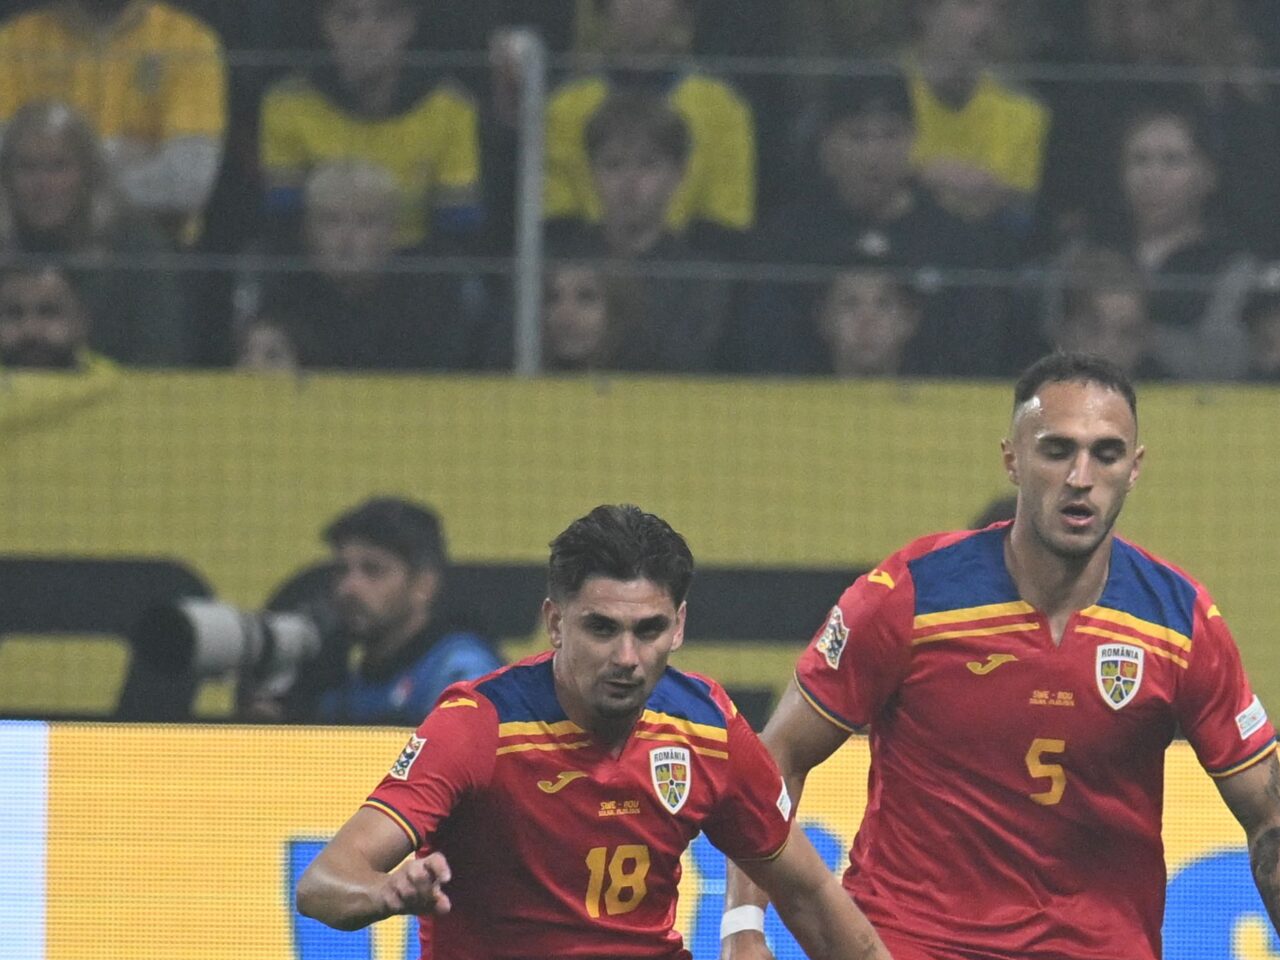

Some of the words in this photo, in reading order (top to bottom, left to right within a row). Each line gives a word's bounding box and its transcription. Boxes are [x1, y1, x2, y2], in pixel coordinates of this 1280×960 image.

[1101, 646, 1139, 660] ROMÂNIA
[1025, 738, 1067, 806] 5
[585, 844, 650, 918] 18
